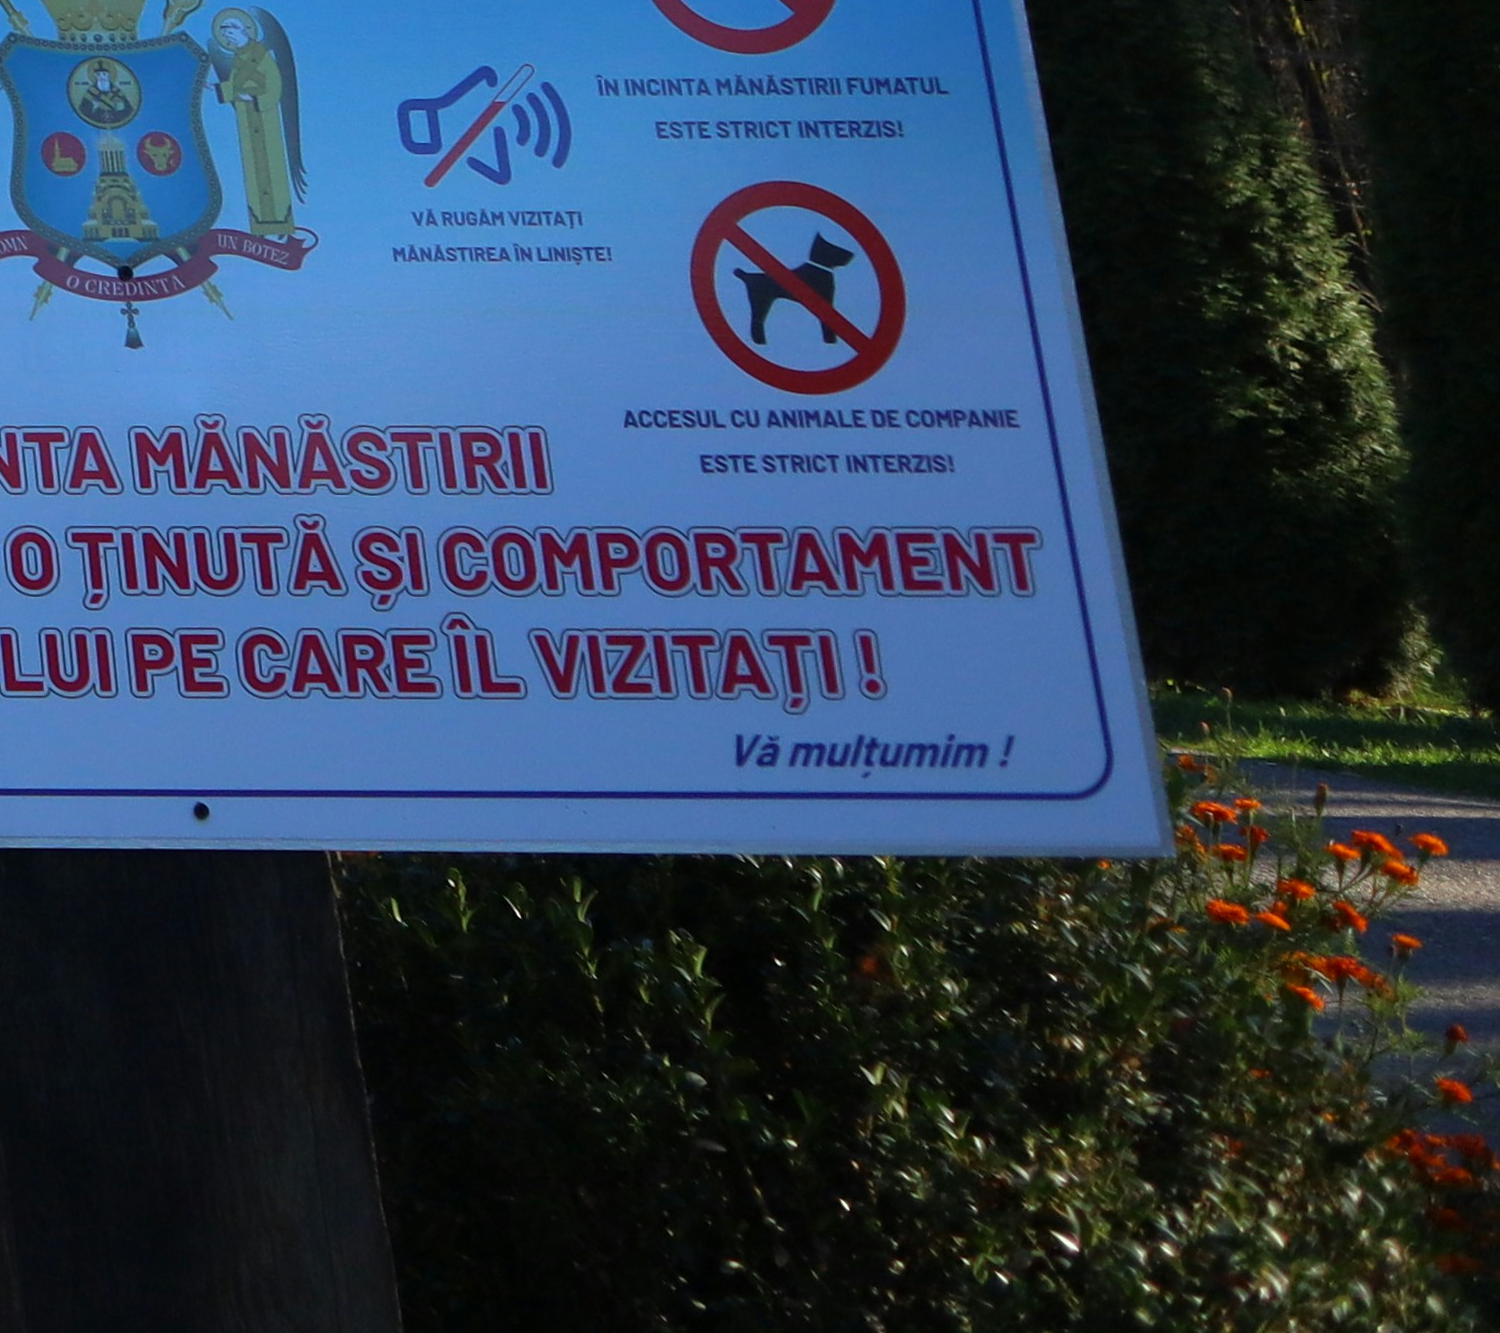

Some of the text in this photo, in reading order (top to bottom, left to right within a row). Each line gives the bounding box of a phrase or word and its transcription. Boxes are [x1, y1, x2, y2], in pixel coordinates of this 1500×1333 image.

[595, 73, 950, 97] ÎN INCINTA MĂNĂSTIRII FUMATUL
[654, 119, 905, 140] ESTE STRICT INTERZIS!
[411, 208, 584, 230] VĂ RUGĂM VIZITAȚI
[392, 242, 613, 266] MĂNĂSTIREA ÎN LINIȘTE!
[67, 275, 79, 290] O
[623, 409, 1021, 429] ACCESUL CU ANIMALE DE COMPANIE
[133, 416, 554, 497] MĂNĂSTIRII
[699, 453, 955, 474] ESTE STRICT INTERZIS!
[8, 528, 61, 595] O
[69, 517, 349, 611] ȚINUTĂ
[351, 525, 431, 611] ȘI
[441, 526, 1041, 597] COMPORTAMENT
[130, 630, 230, 698] PE
[241, 629, 443, 700] CARE
[443, 615, 528, 701] ÎL
[533, 630, 845, 714] VIZITAȚI
[735, 734, 781, 768] Vă
[788, 733, 990, 779] mulțumim
